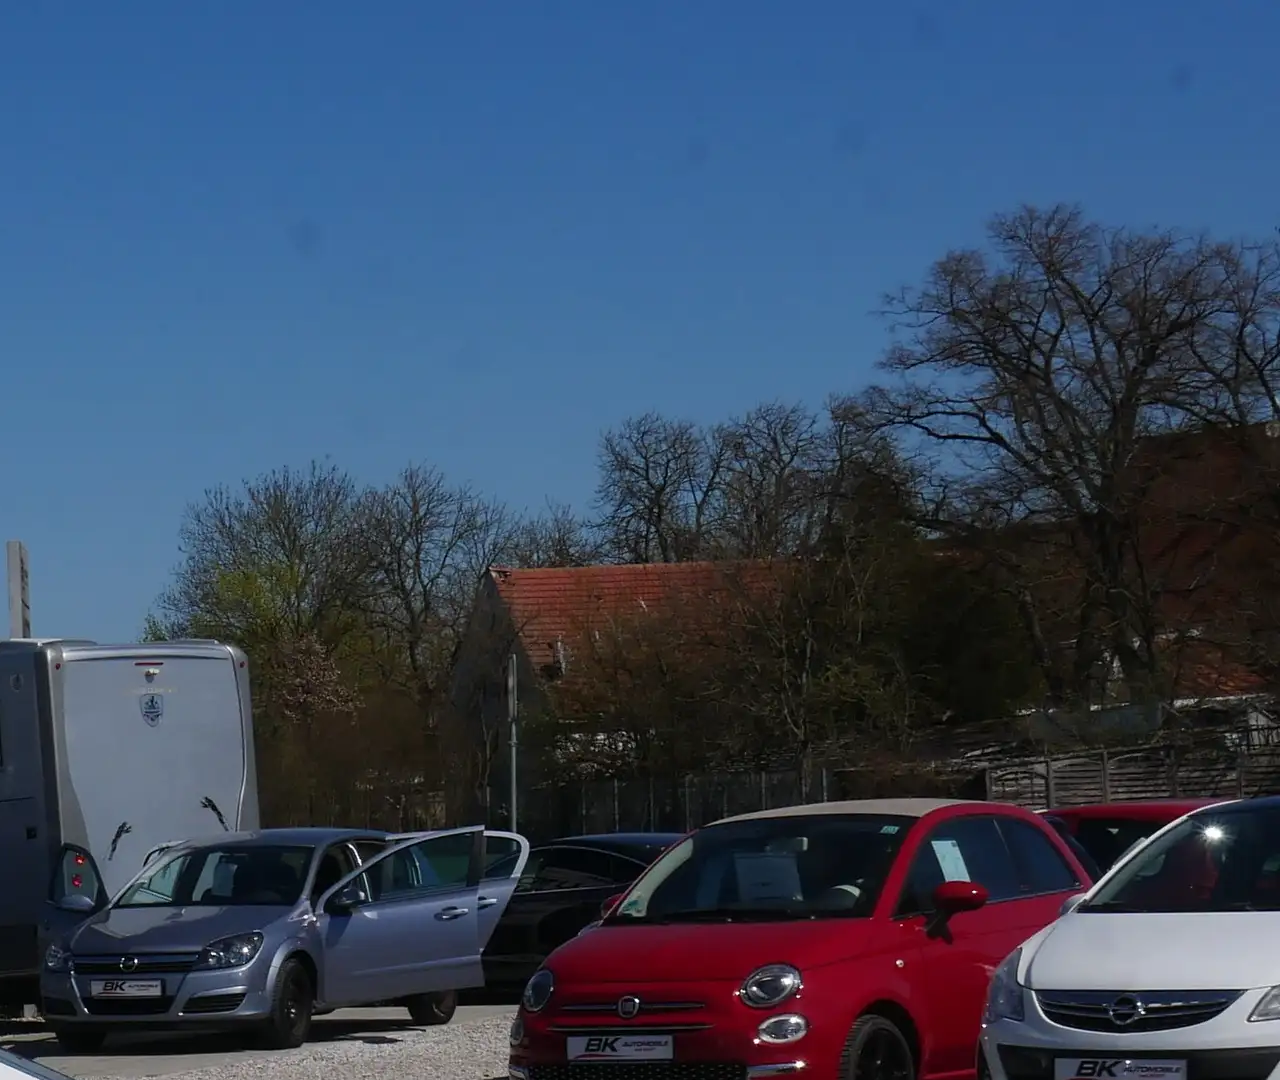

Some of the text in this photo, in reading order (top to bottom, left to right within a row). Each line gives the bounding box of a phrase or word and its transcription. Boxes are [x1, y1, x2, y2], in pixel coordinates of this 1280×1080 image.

[103, 981, 127, 992] BK
[584, 1036, 622, 1053] BK
[1075, 1060, 1123, 1078] BK
